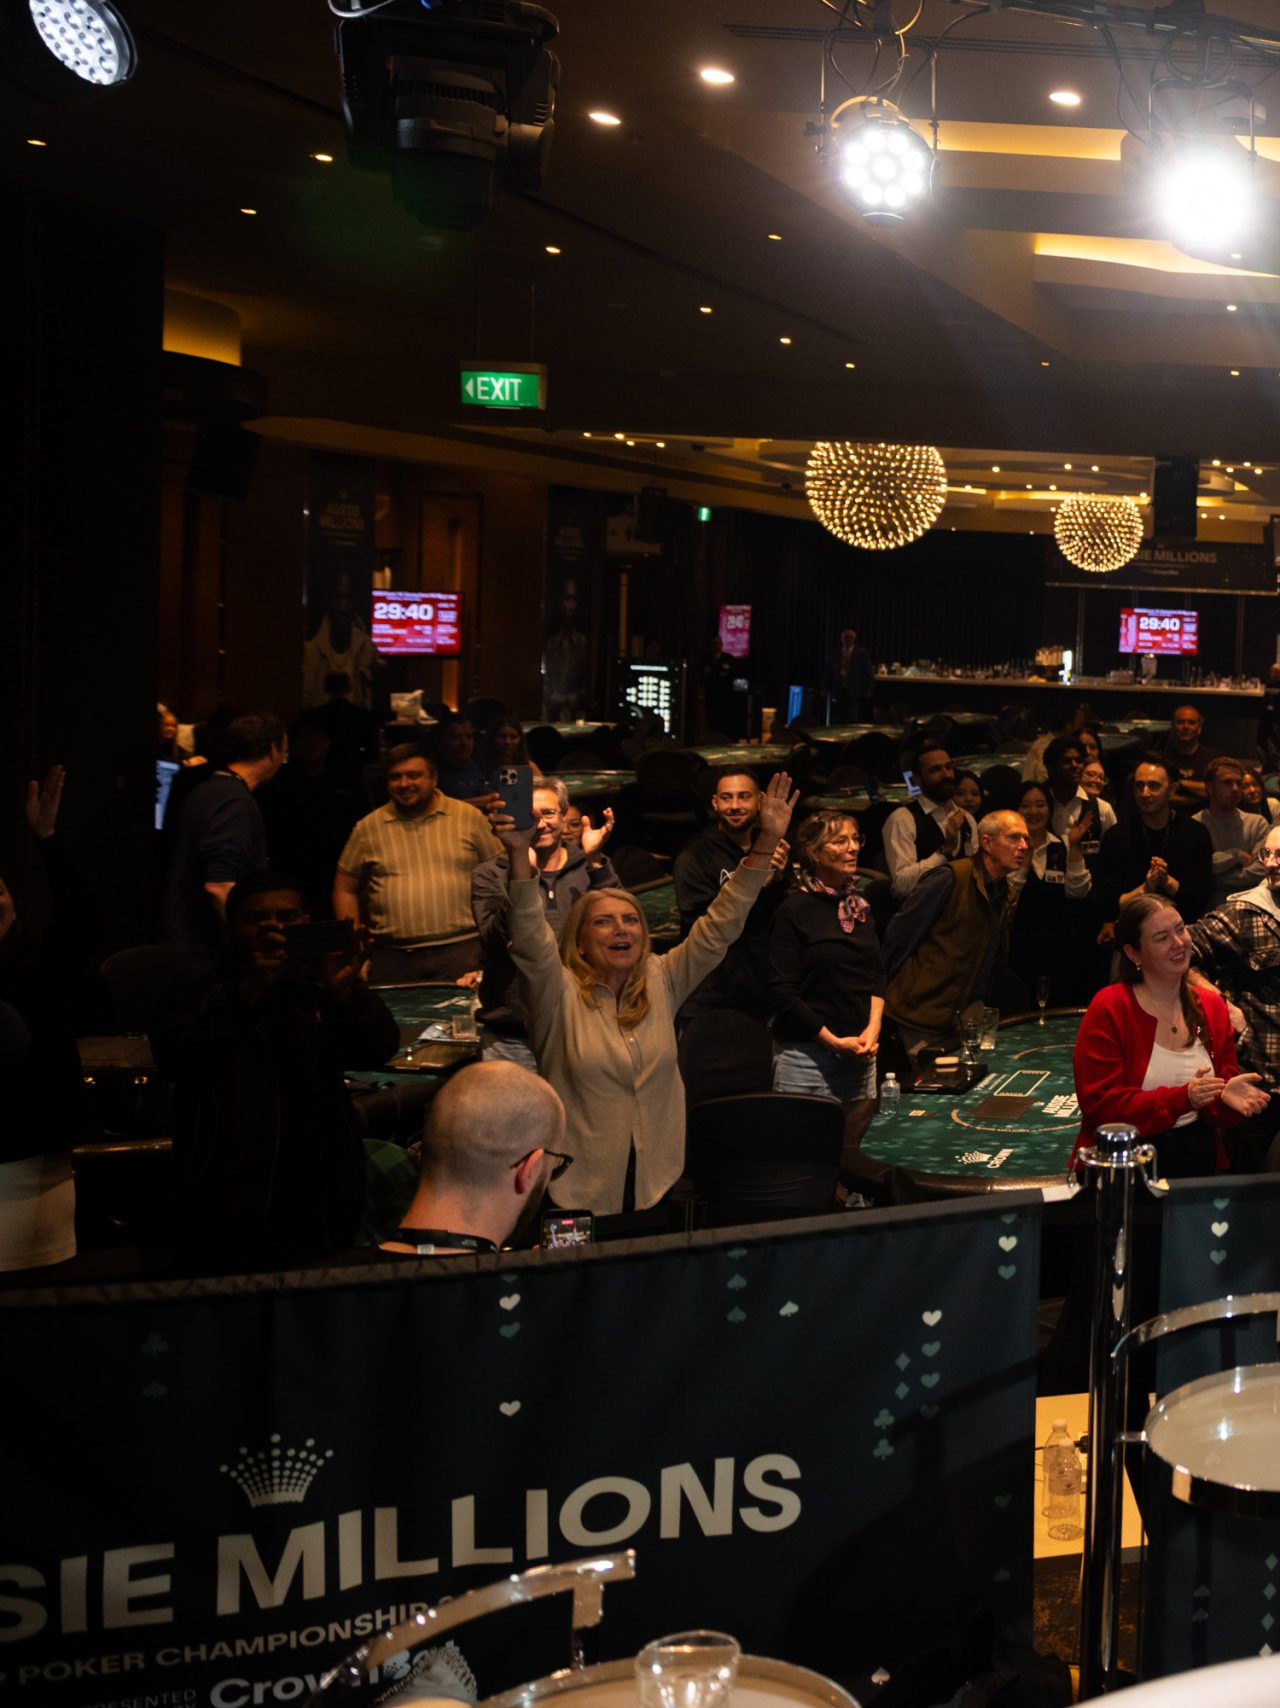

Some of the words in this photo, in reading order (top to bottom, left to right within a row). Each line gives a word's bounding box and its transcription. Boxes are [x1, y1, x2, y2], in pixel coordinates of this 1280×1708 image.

[477, 376, 524, 402] EXIT
[1154, 549, 1218, 564] MILLIONS
[373, 602, 434, 620] 29:40
[1139, 616, 1182, 632] 29:40
[0, 1541, 176, 1644] SIE
[217, 1452, 803, 1617] MILLIONS
[18, 1651, 146, 1686] POKER
[154, 1595, 454, 1668] CHAMPIONSHIP
